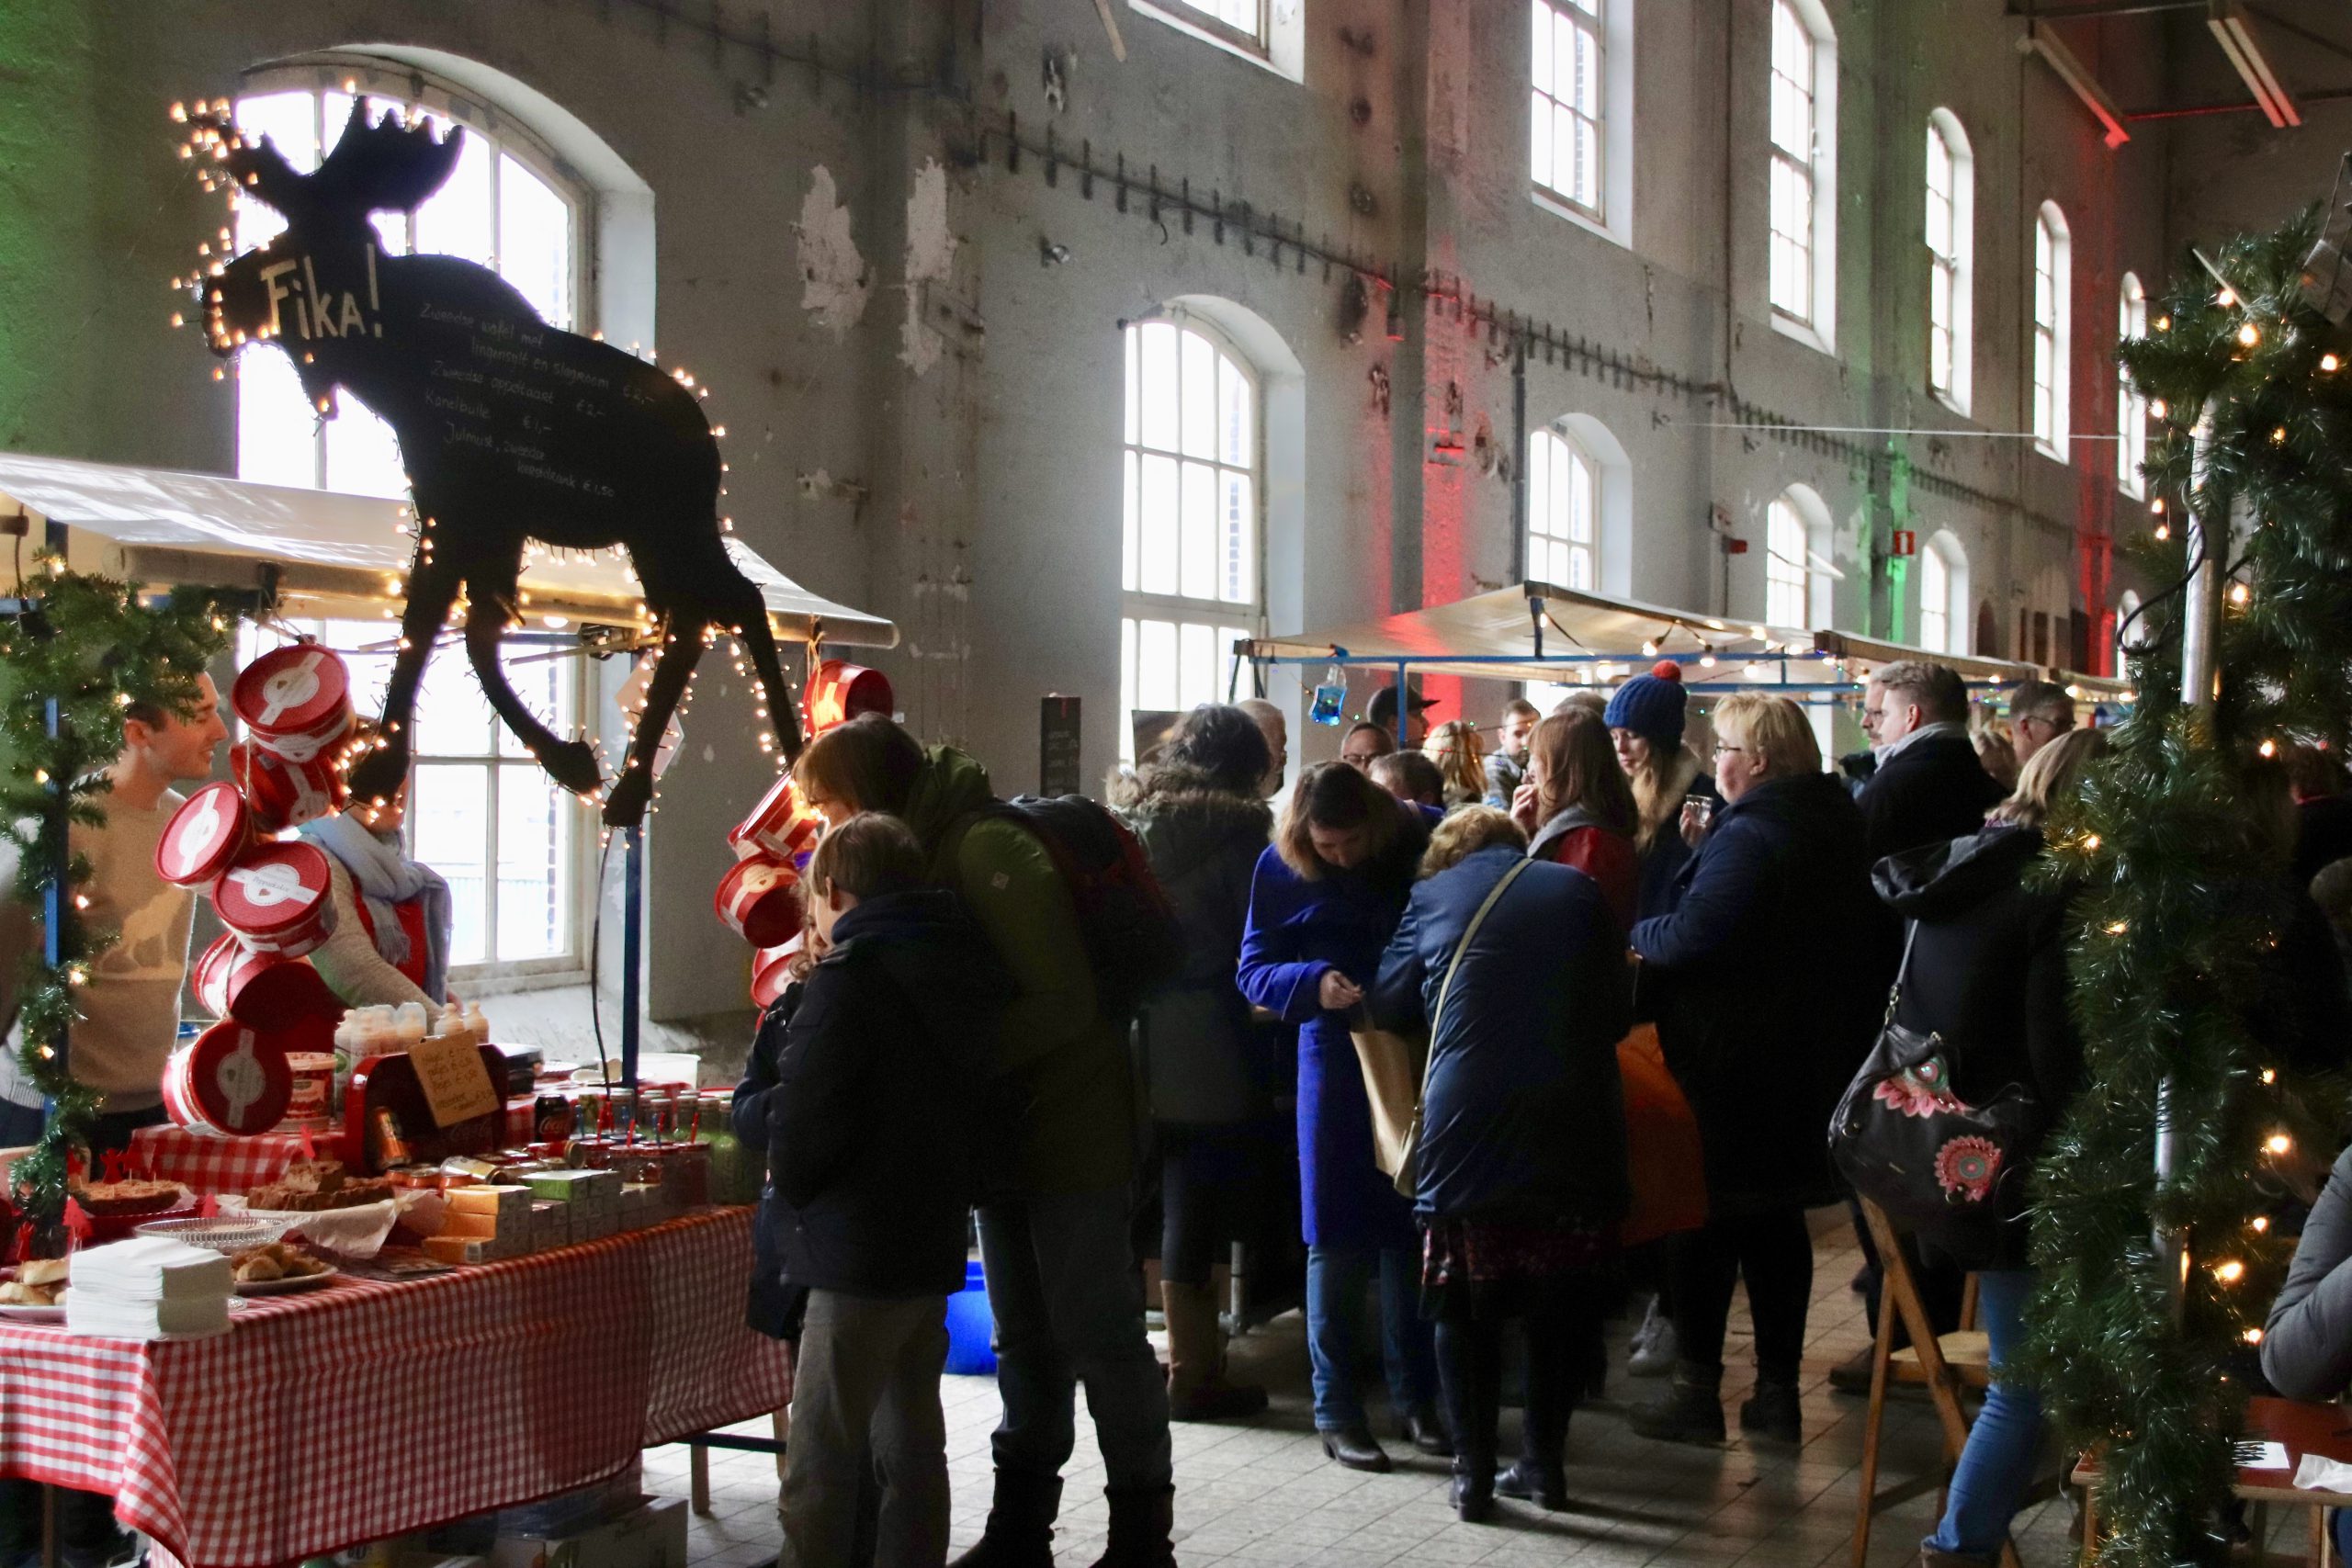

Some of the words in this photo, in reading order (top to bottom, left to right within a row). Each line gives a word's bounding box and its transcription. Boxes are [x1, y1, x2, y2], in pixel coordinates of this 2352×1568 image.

[420, 303, 474, 326] Zweedse
[482, 319, 514, 341] wafel
[522, 333, 544, 350] met
[534, 357, 548, 371] en
